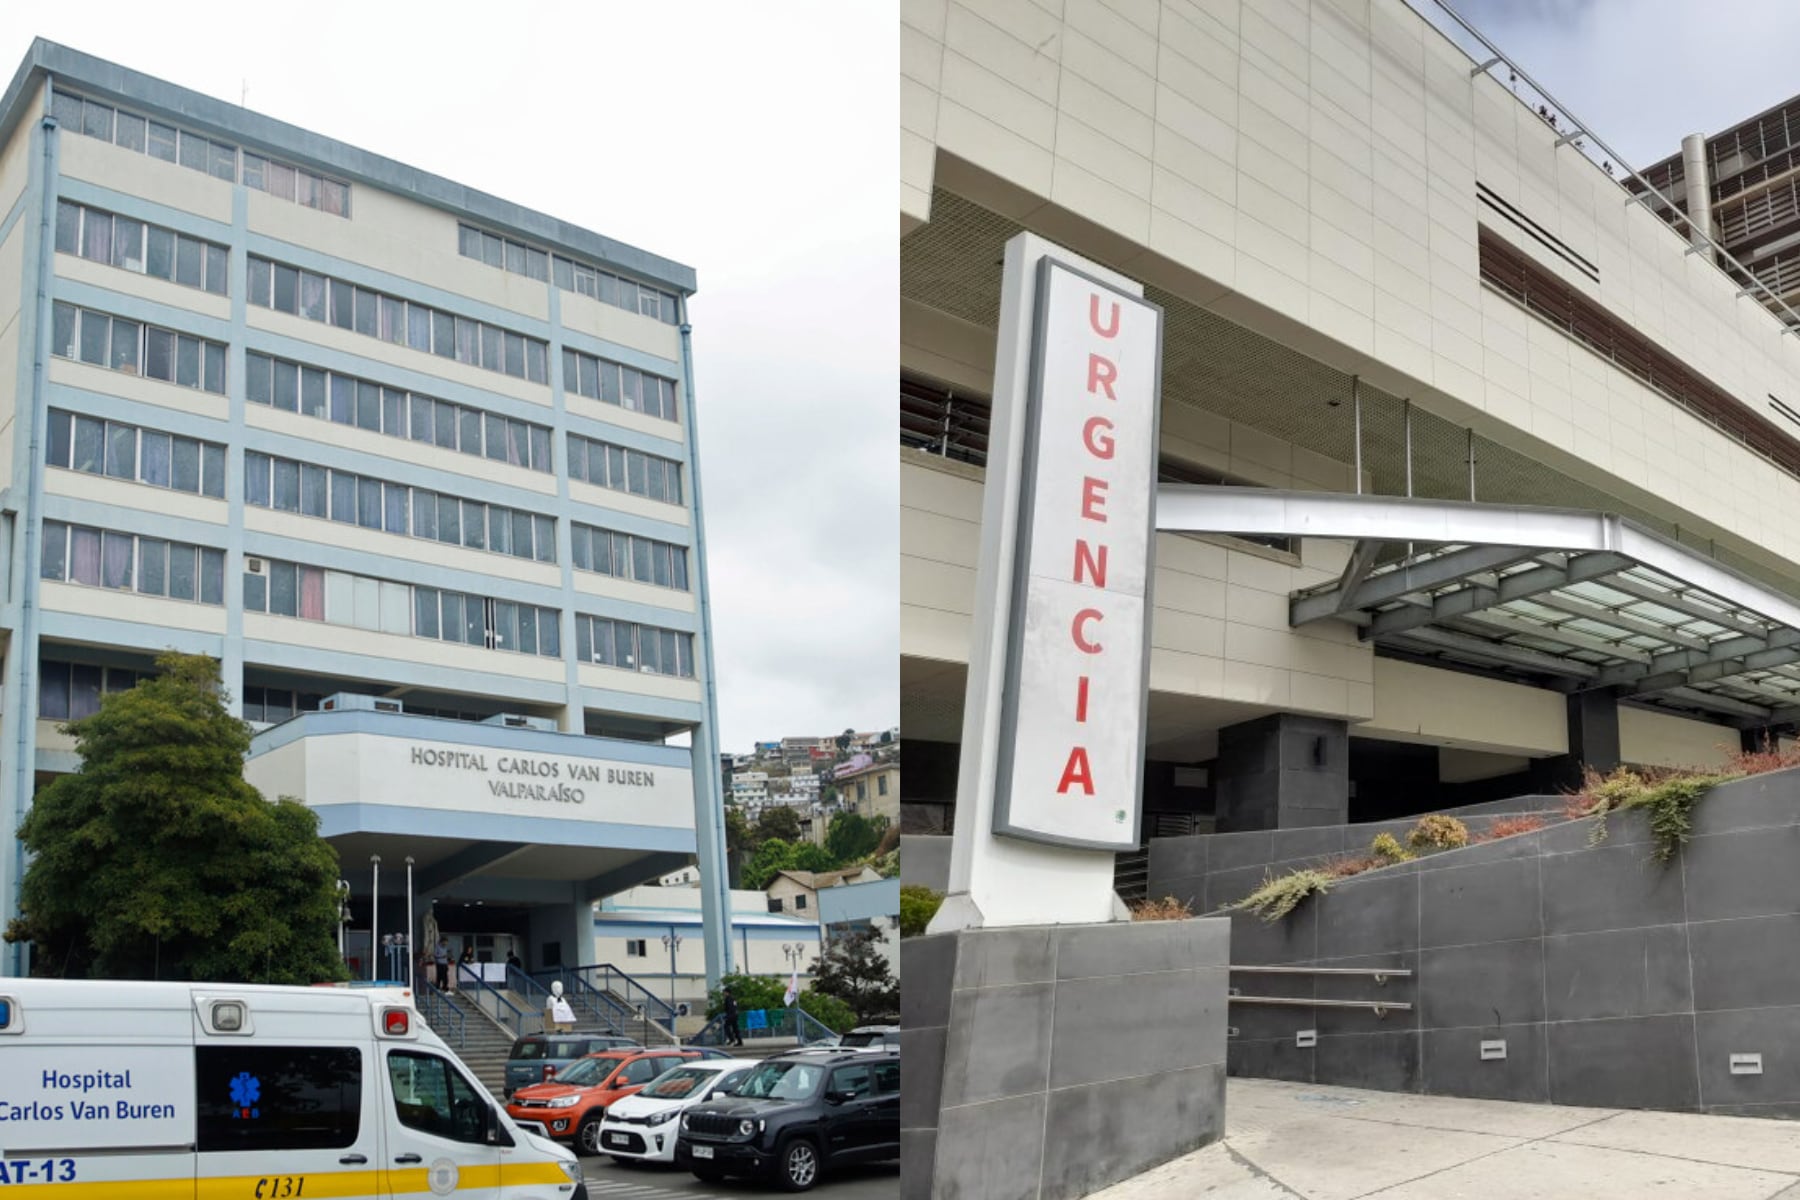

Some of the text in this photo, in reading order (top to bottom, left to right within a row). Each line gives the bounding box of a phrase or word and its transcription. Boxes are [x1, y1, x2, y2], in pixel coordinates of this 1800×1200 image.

[1057, 293, 1121, 796] URGENCIA
[411, 747, 655, 787] HOSPITAL CARLOS VAN BUREN
[488, 780, 585, 804] VALPARAÍSO
[42, 1069, 132, 1093] Hospital
[0, 1100, 175, 1121] Carlos Van Buren
